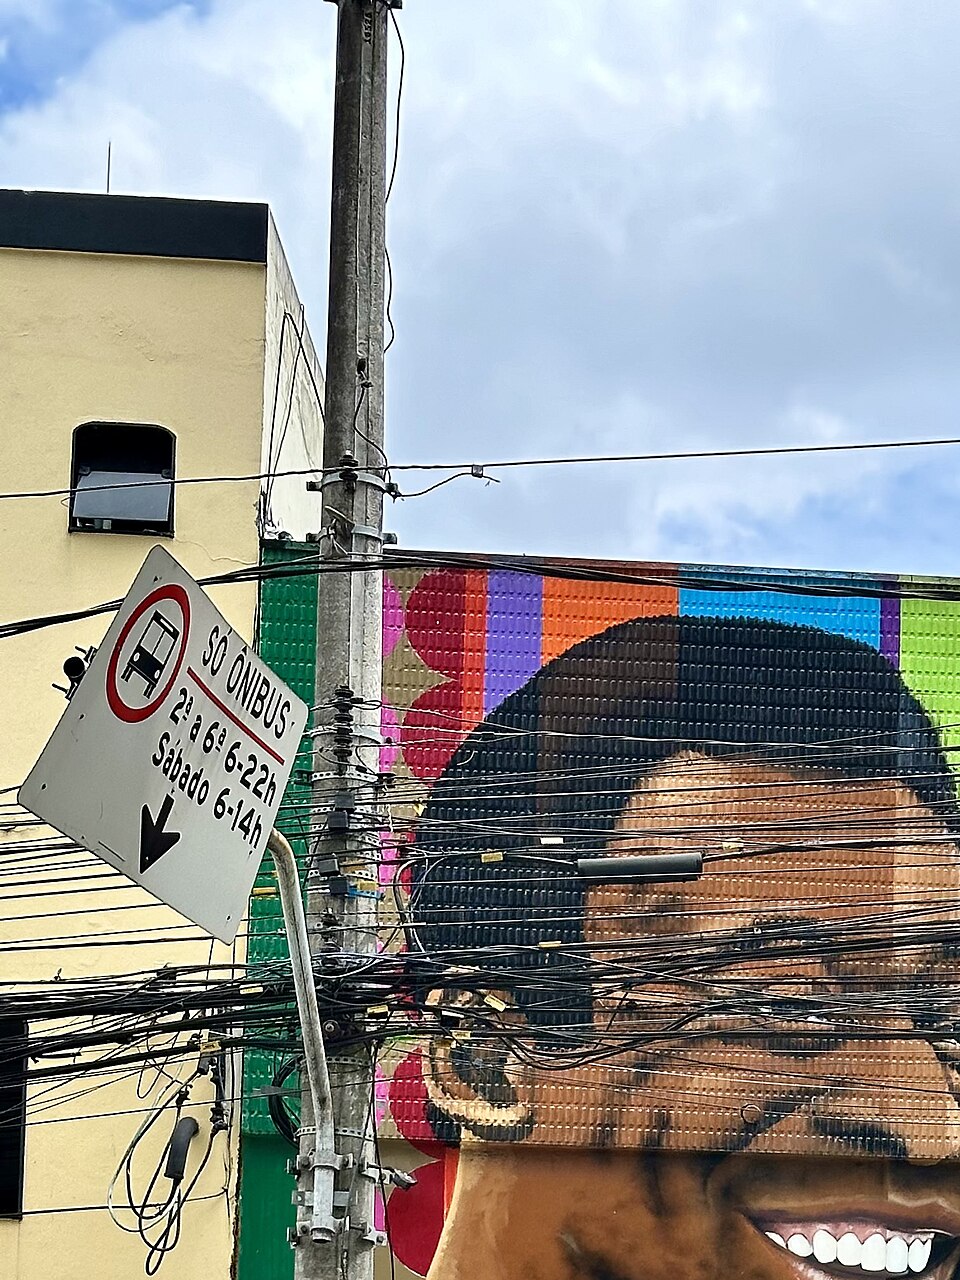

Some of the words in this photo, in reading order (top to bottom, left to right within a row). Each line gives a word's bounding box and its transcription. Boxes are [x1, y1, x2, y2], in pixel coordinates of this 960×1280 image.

[202, 625, 233, 677] SÓ
[226, 645, 291, 739] ÔNIBUS
[151, 731, 210, 806] Sábado
[213, 787, 262, 849] 6-14h
[189, 714, 202, 742] a
[224, 741, 277, 807] 6-22h
